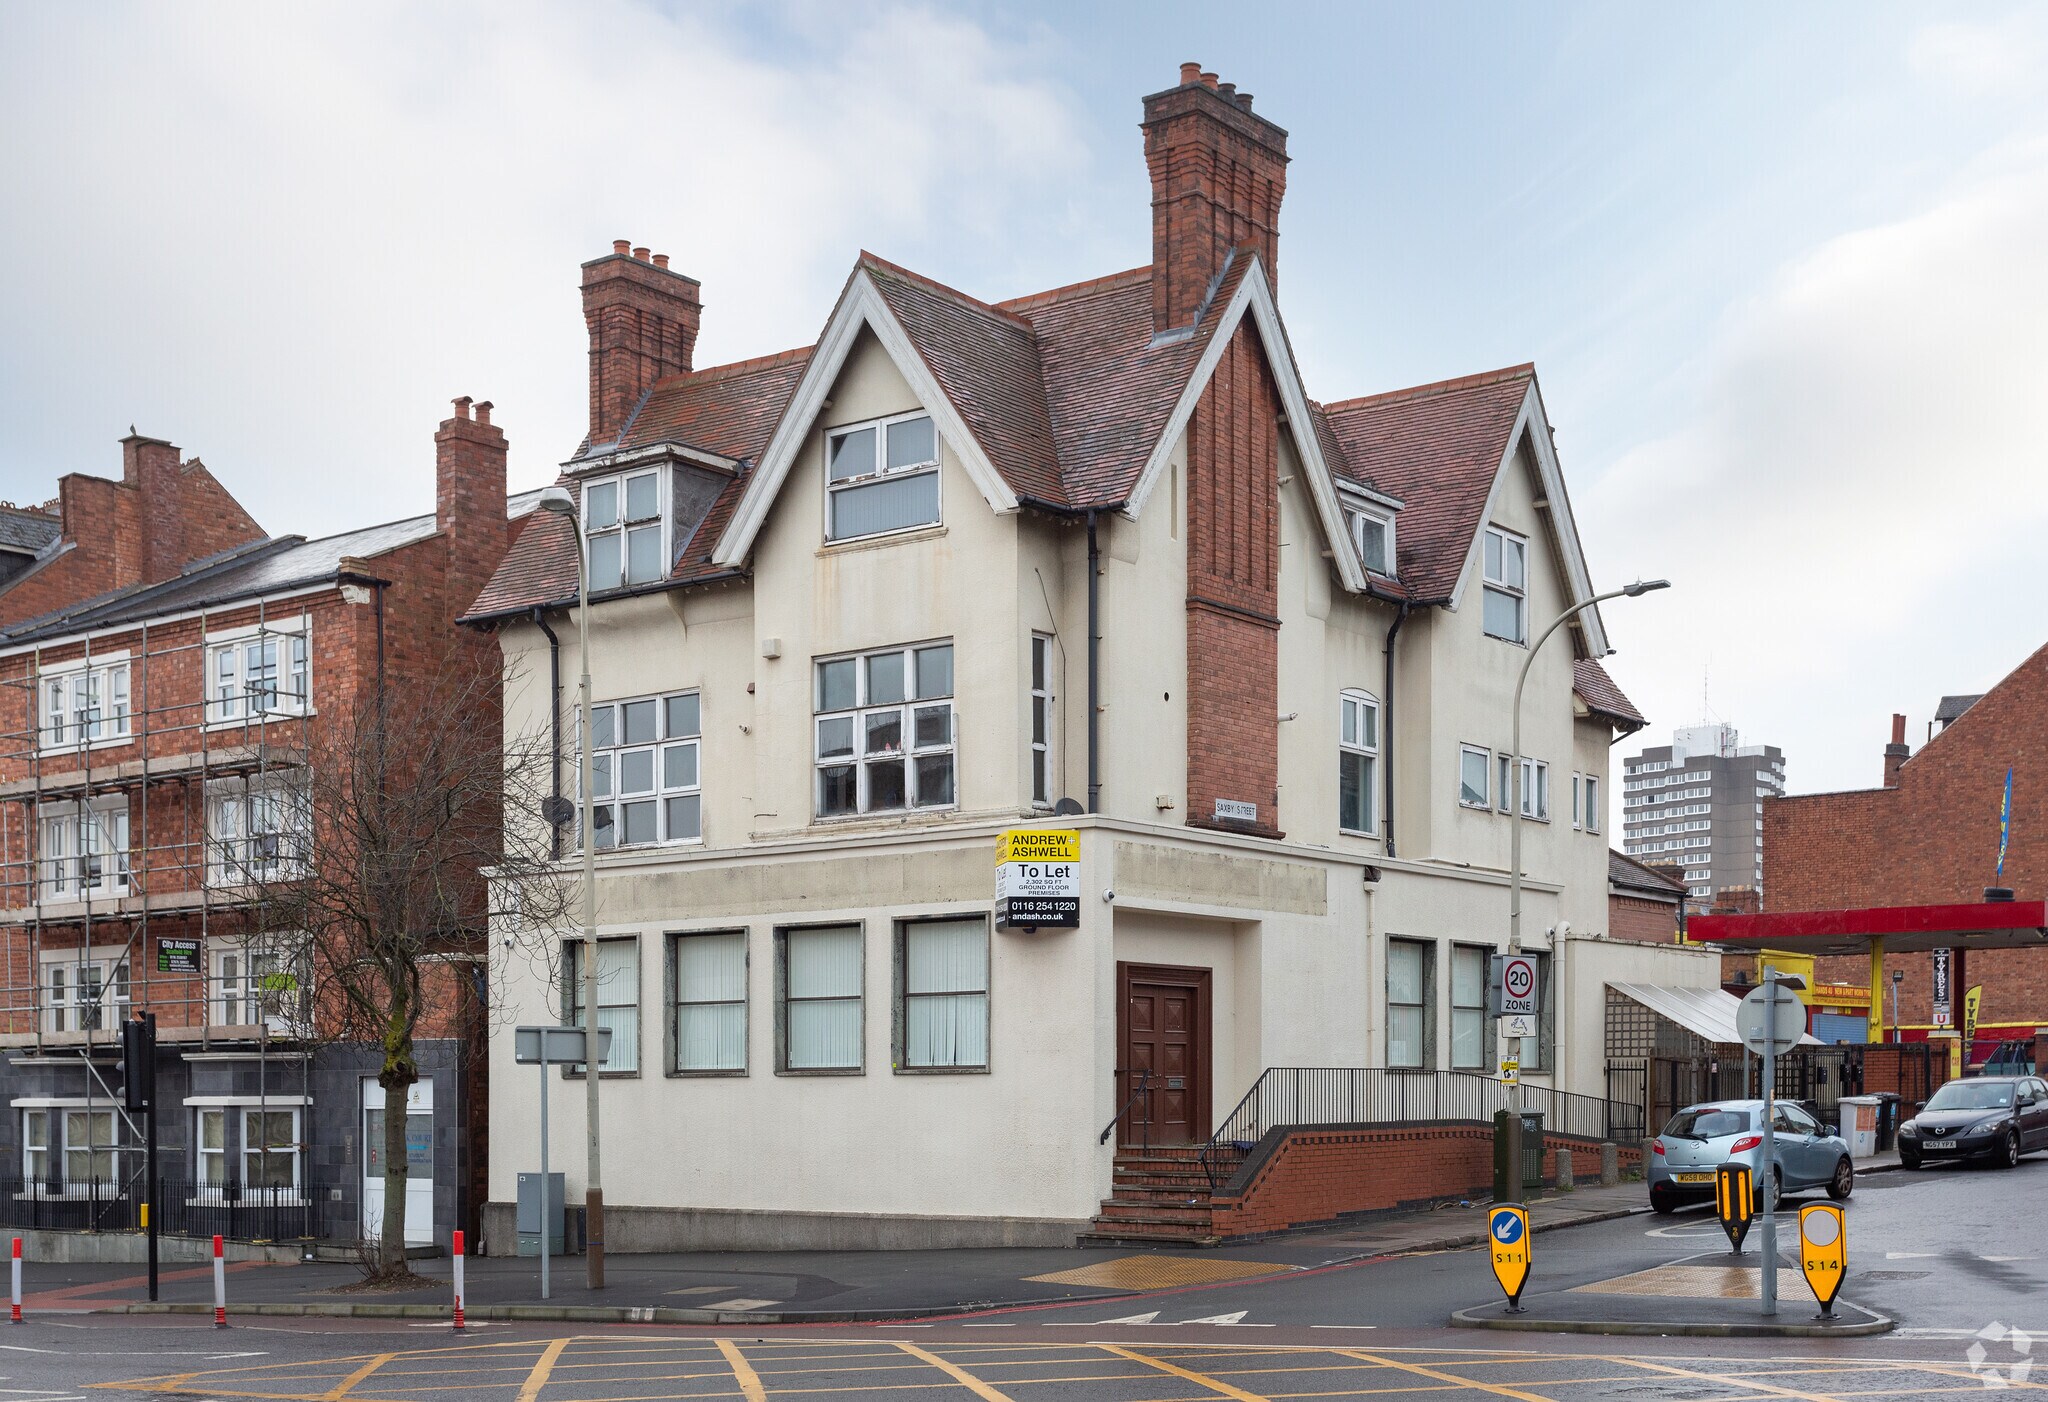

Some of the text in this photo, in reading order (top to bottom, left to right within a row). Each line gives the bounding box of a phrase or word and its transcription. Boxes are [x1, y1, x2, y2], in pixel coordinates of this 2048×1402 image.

[1216, 803, 1255, 815] SAXBY STREET
[1012, 847, 1071, 857] ASHWELL
[1018, 864, 1039, 878] To
[1045, 864, 1070, 878] Let
[1012, 901, 1034, 911] 0116
[1036, 902, 1053, 911] 254
[1055, 902, 1076, 911] 1220
[1012, 912, 1064, 920] andash.co.uk
[162, 940, 196, 949] City Access
[1510, 971, 1529, 987] 20
[1936, 957, 1945, 997] TYRES
[1505, 1000, 1531, 1011] ZONE
